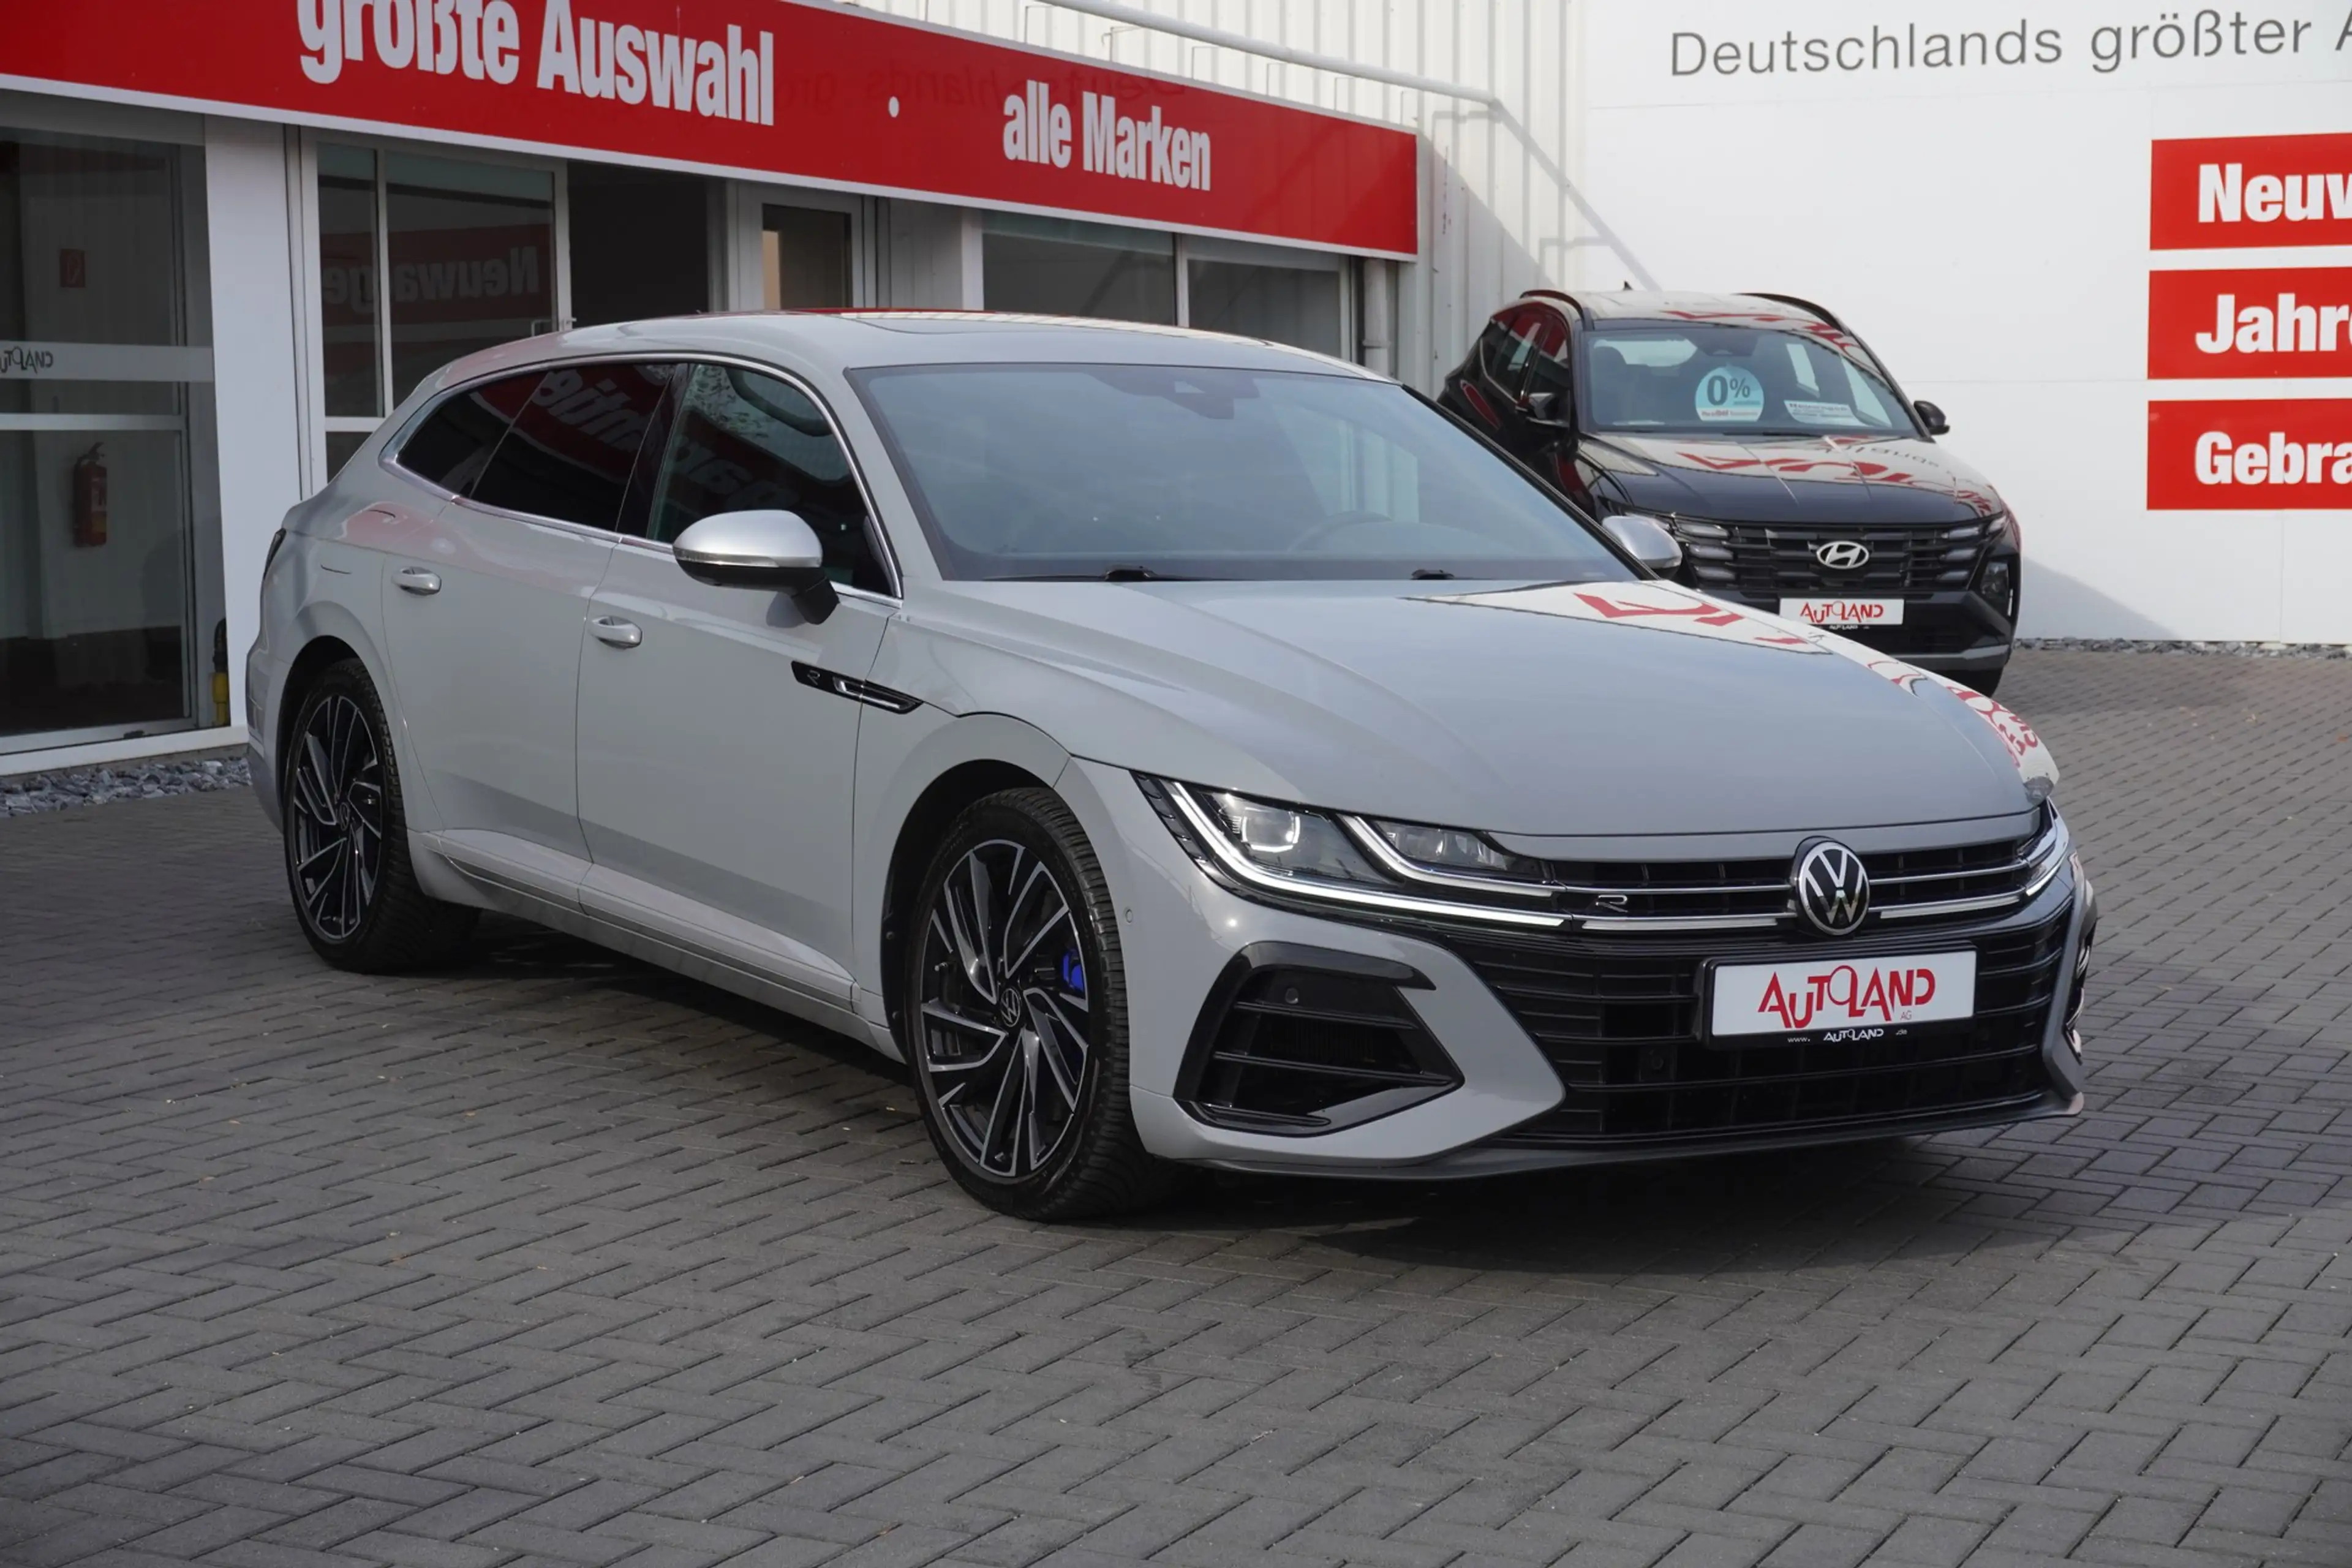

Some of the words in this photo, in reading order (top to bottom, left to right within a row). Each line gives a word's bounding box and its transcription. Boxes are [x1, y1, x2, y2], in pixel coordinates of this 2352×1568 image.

[1672, 19, 2062, 76] Deutschlands
[2091, 9, 2312, 73] größter
[537, 0, 774, 126] Auswahl
[1003, 79, 1071, 168] alle
[1082, 91, 1211, 191] Marken
[2195, 293, 2352, 353] Jahr
[1706, 374, 1751, 406] 0%
[1900, 1011, 1912, 1020] AG
